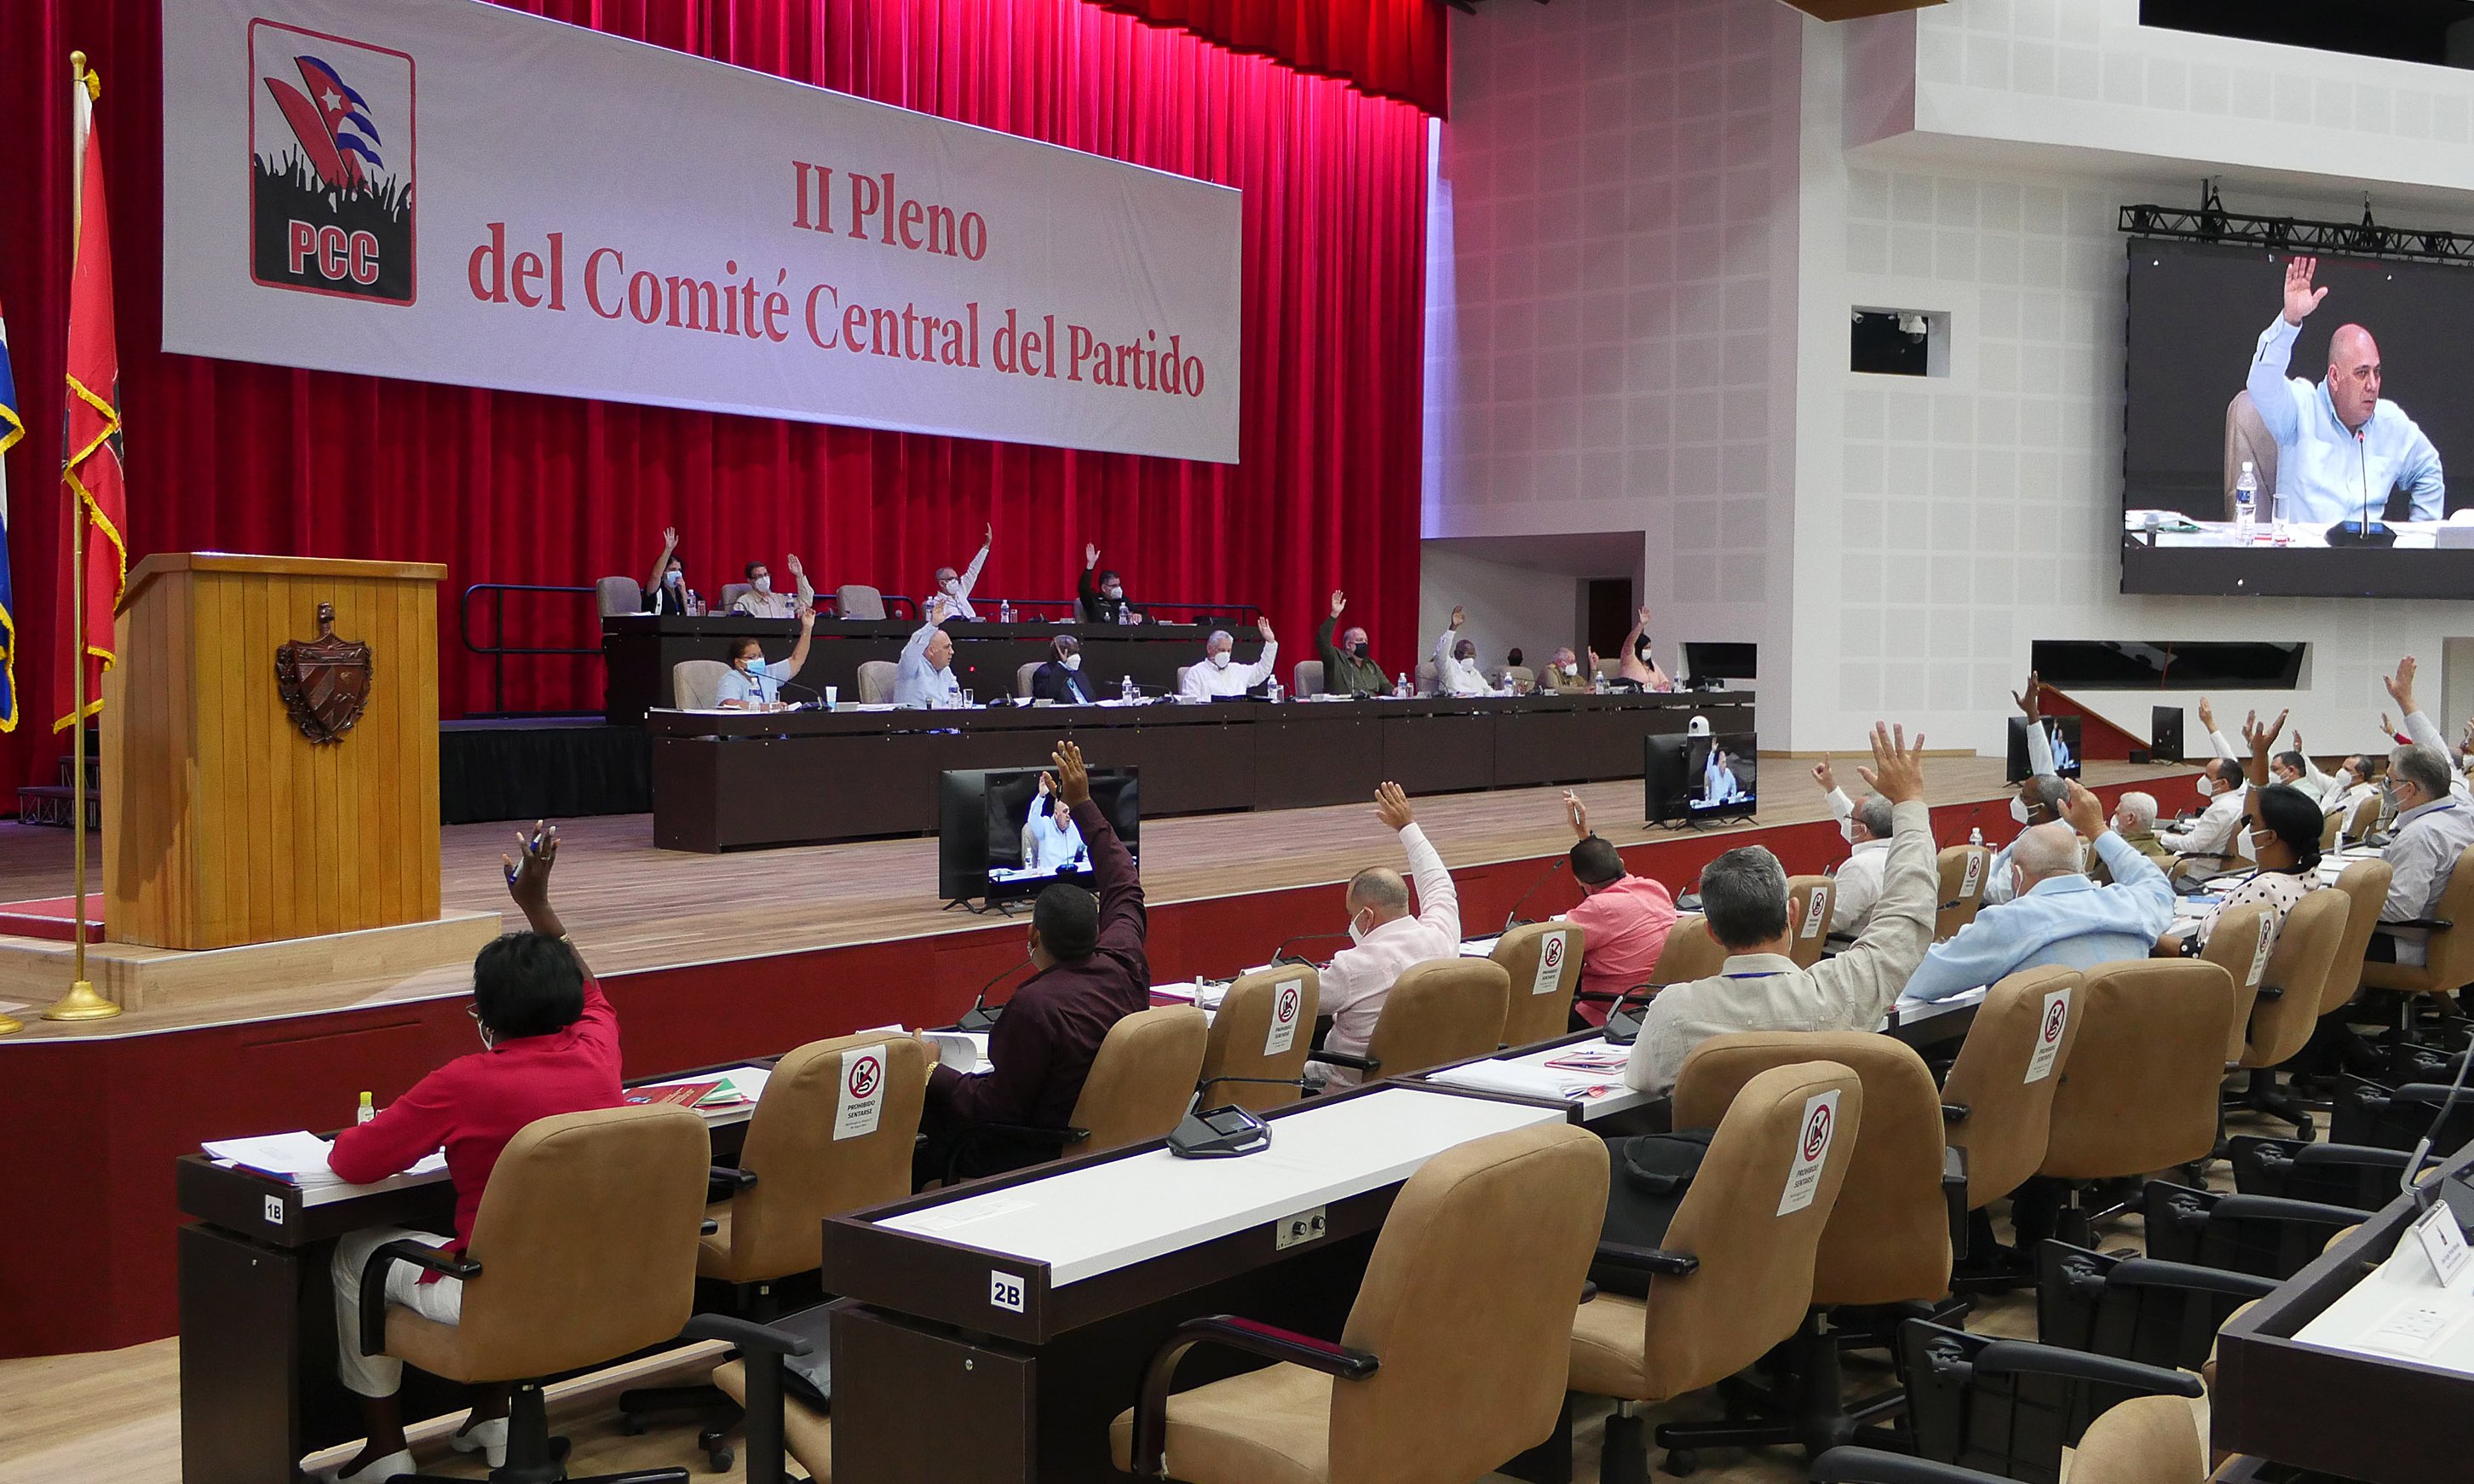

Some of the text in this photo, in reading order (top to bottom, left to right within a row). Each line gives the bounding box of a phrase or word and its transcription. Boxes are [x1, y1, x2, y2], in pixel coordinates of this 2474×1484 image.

[792, 160, 988, 262] II Pleno
[289, 219, 379, 285] PCC
[468, 221, 1205, 398] del Comité Central del Partido
[847, 1100, 876, 1111] PROHIBIDO
[847, 1108, 872, 1119] SENTARSE
[268, 1203, 281, 1220] 1B
[994, 1282, 1020, 1306] 2B
